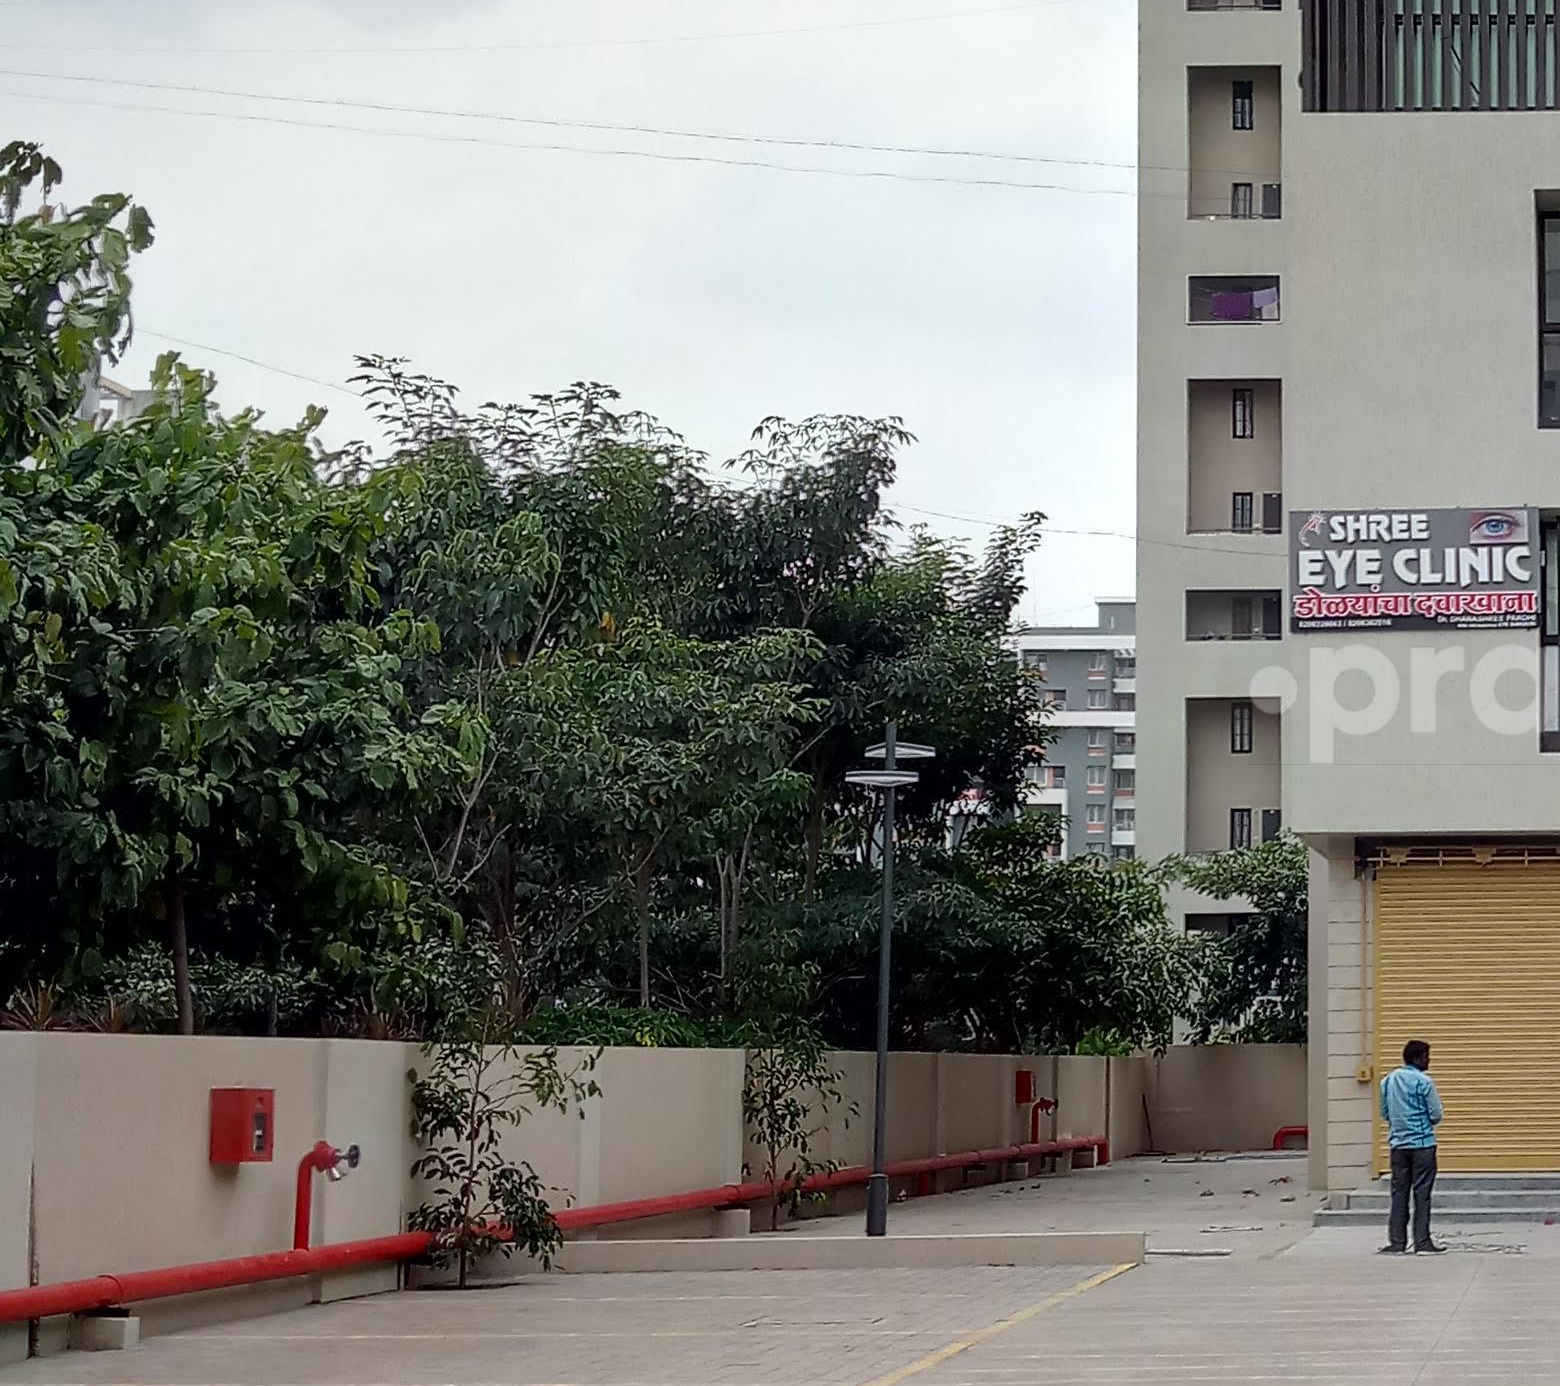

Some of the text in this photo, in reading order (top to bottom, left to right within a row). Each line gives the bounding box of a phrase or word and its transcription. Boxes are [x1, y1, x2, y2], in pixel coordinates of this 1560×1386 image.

[1329, 514, 1430, 543] SHREE
[1298, 546, 1532, 589] EYE CLINIC
[1414, 591, 1538, 618] दवाखाना
